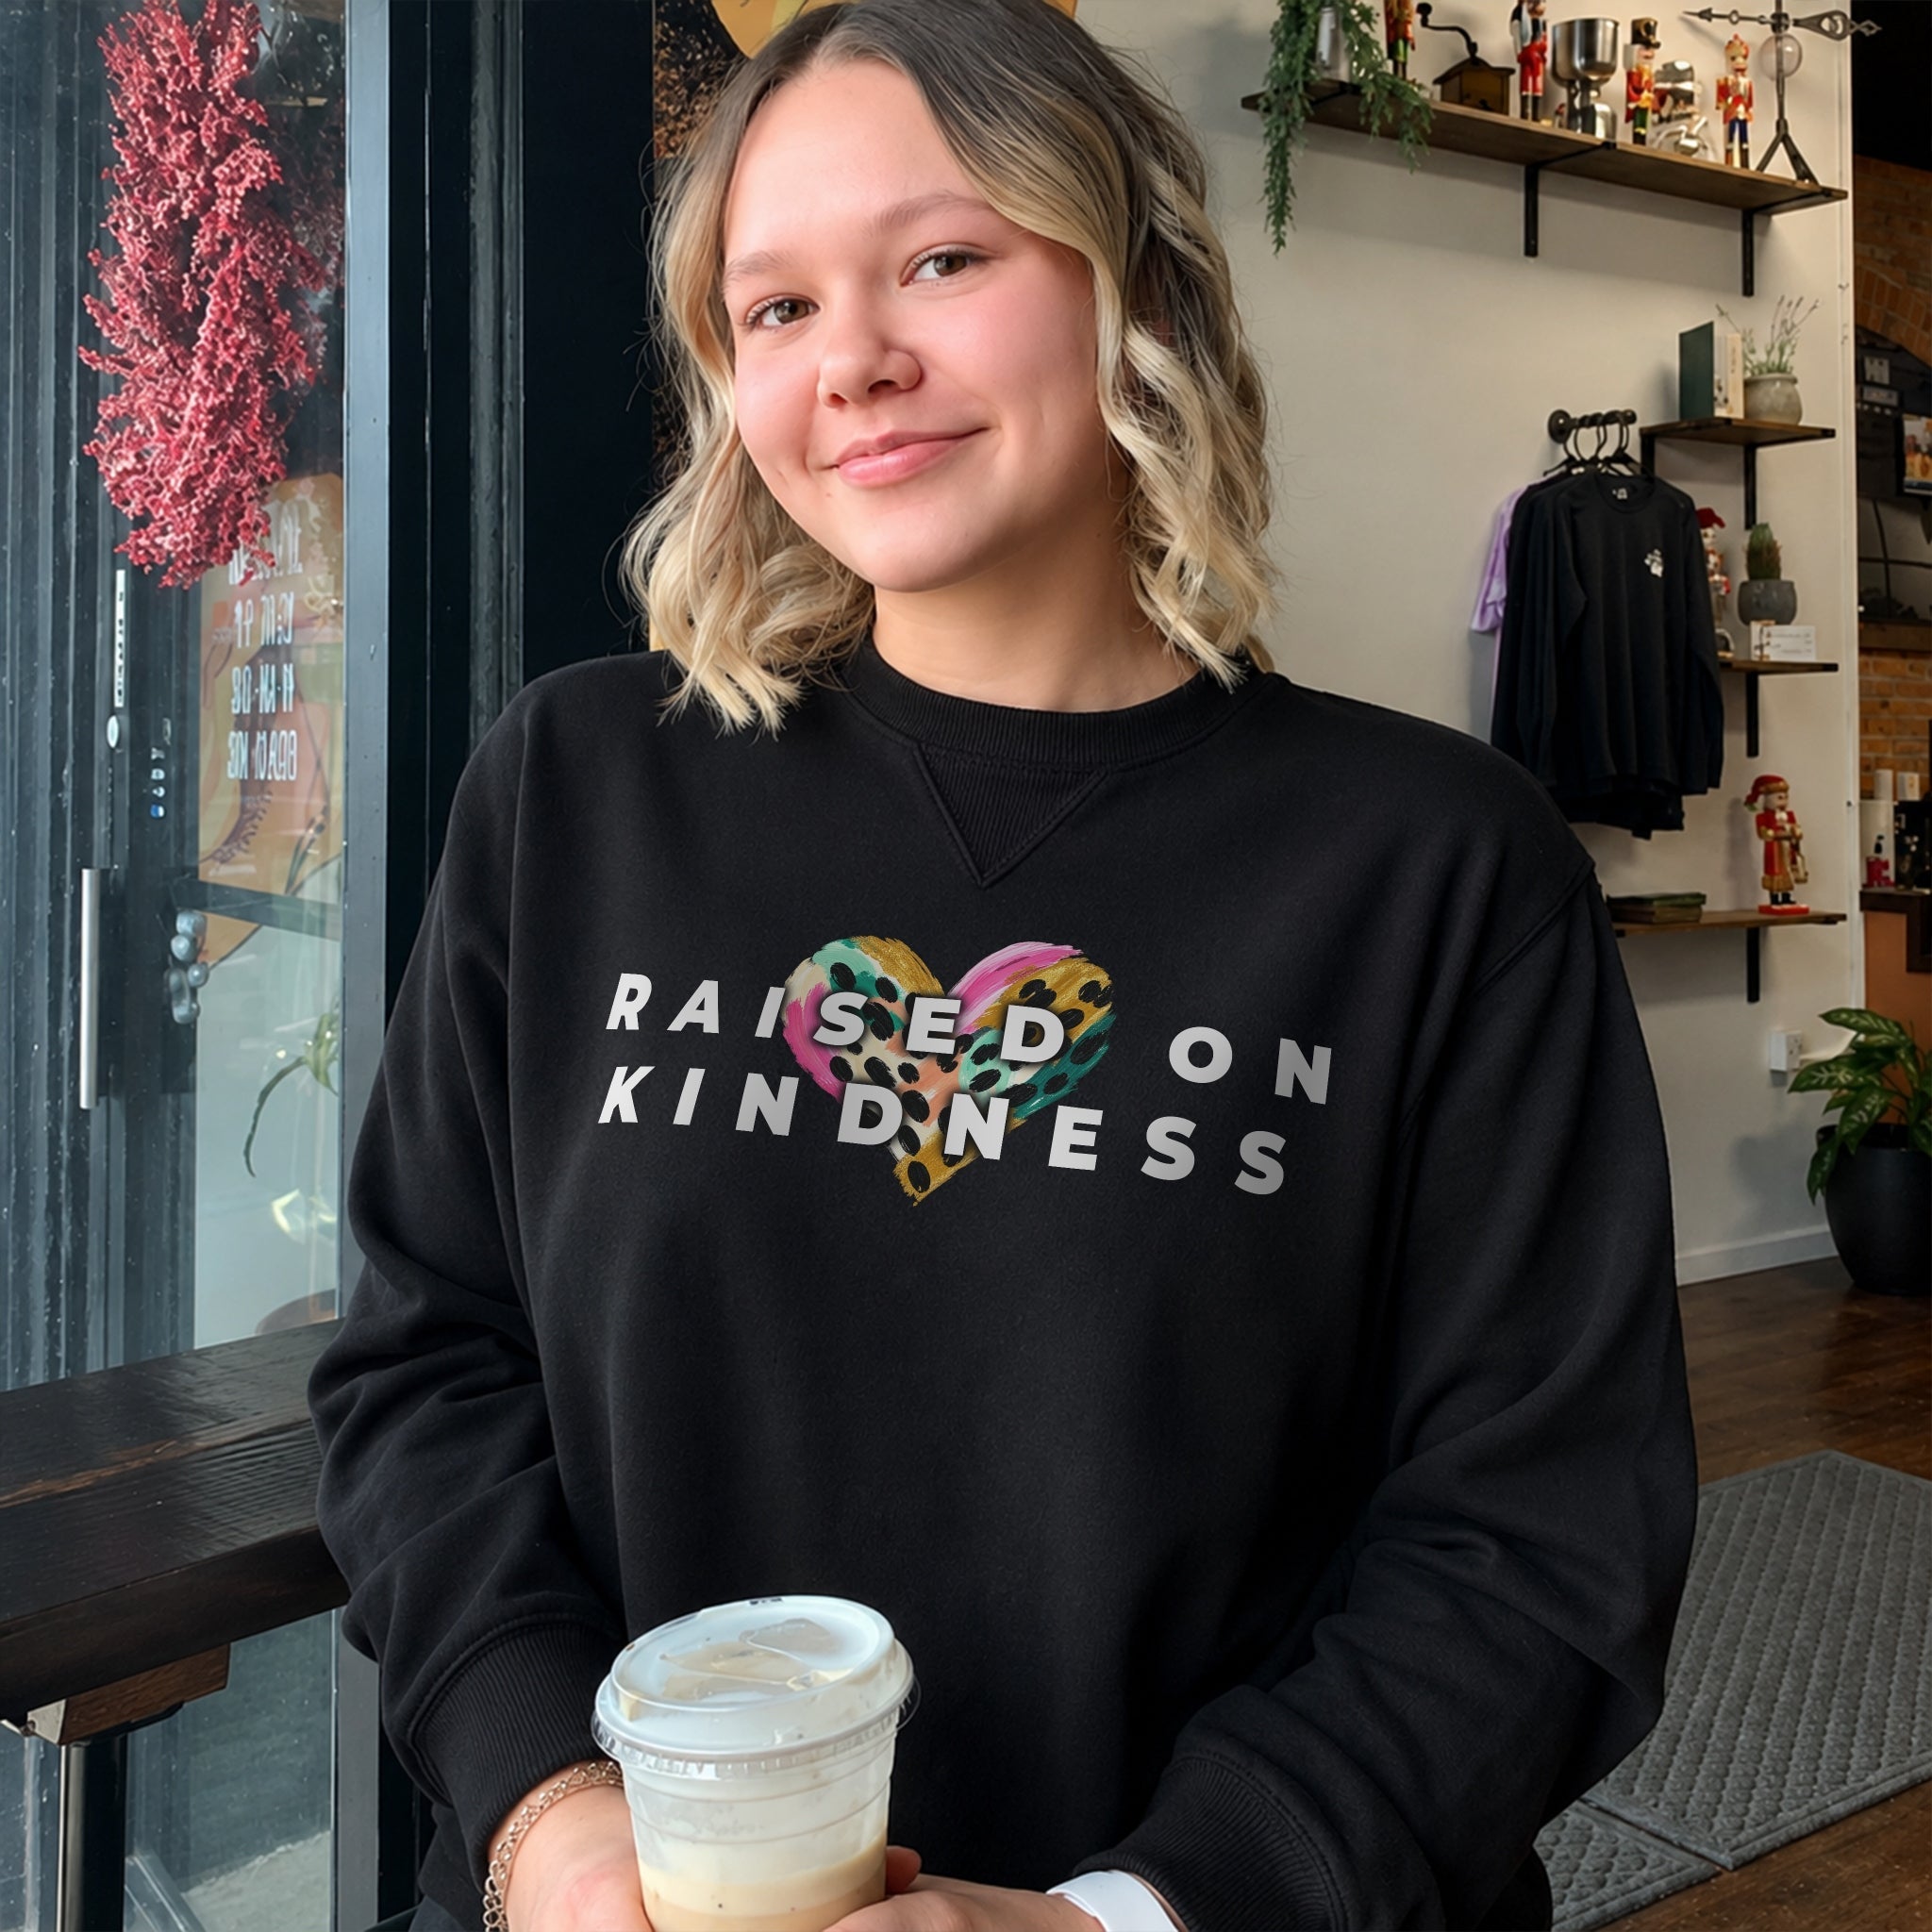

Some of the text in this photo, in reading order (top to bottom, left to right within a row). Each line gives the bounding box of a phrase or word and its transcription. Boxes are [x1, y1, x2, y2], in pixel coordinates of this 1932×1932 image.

[606, 973, 1332, 1105] RAISED ON
[597, 1065, 1287, 1196] KINDNESS
